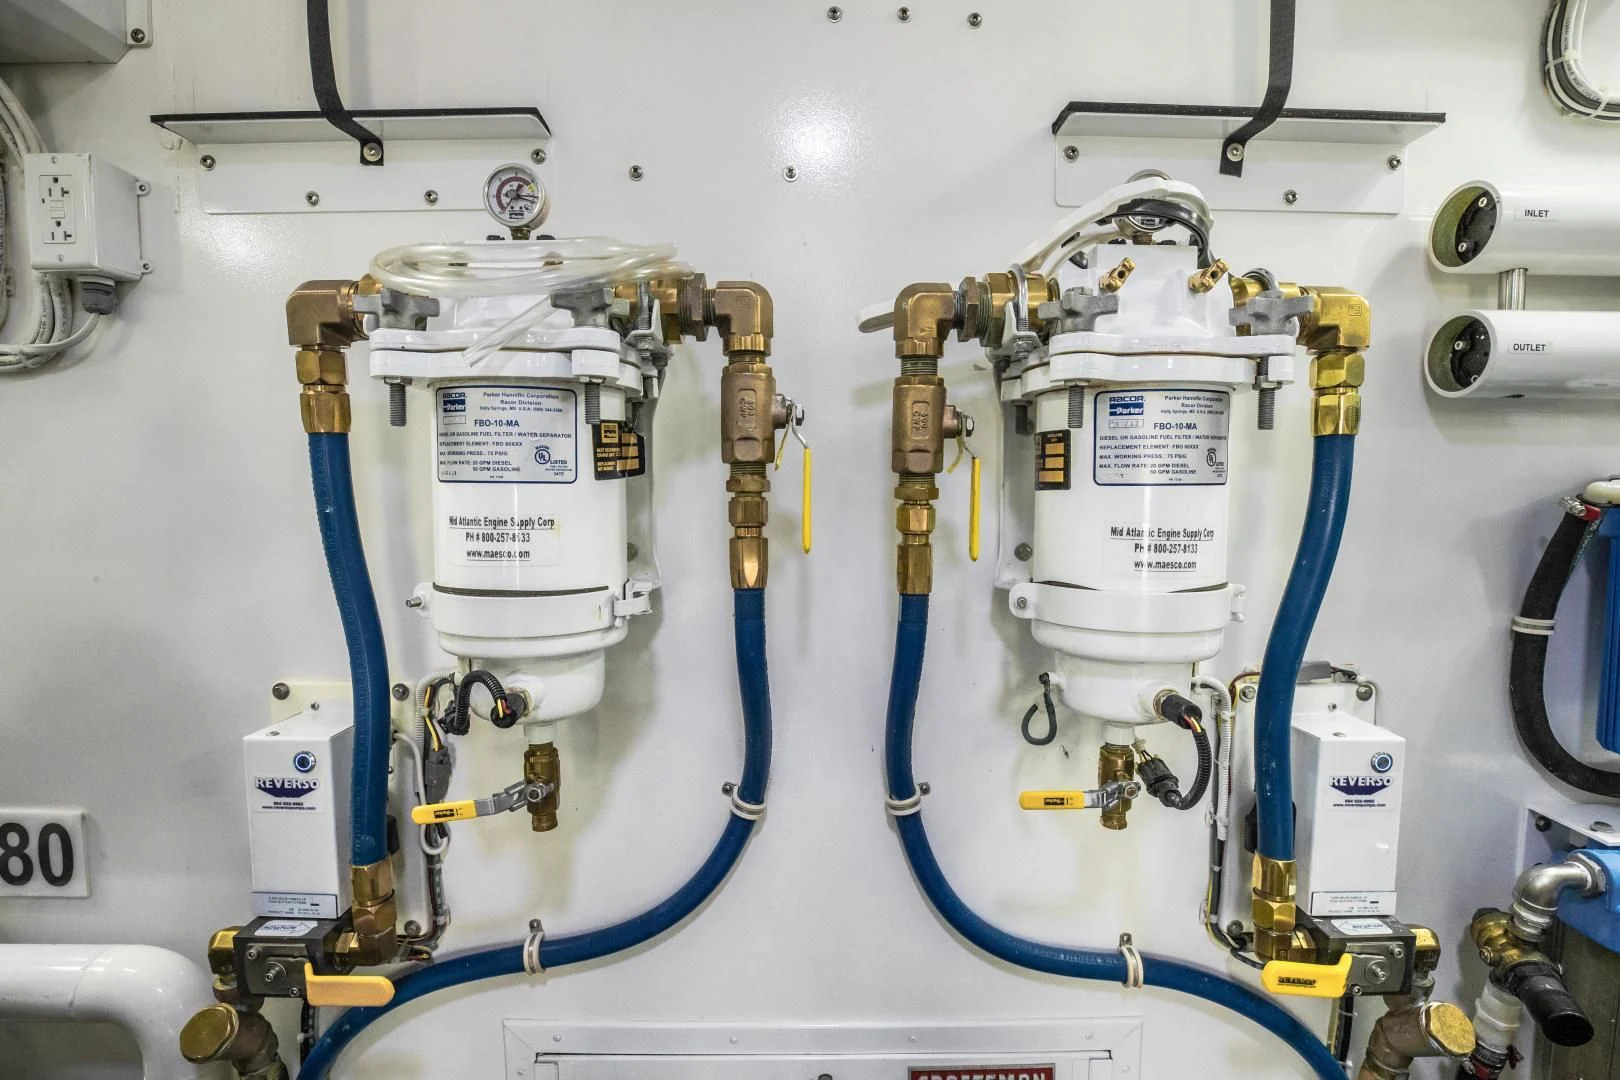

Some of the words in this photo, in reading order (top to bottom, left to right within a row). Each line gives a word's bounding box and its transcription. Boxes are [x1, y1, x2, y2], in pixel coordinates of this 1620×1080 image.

[1524, 209, 1549, 217] INLET
[1513, 343, 1546, 351] OUTLET
[447, 404, 466, 412] Parker
[1116, 406, 1144, 414] Parker
[474, 419, 520, 428] FBO-10-MA
[1154, 422, 1198, 430] FBO-10-MA
[459, 516, 482, 526] Atlantic
[484, 516, 508, 530] Engine
[538, 517, 555, 530] Corp
[466, 532, 474, 542] PH
[476, 532, 480, 541] #
[482, 532, 531, 543] 800-257-8133
[1110, 526, 1124, 537] Mid
[1126, 527, 1155, 538] Atlaic
[1157, 528, 1180, 540] Engine
[1182, 528, 1202, 541] Supply
[1203, 528, 1214, 540] Corp
[1134, 544, 1144, 552] PH
[1147, 544, 1152, 552] #
[1154, 544, 1198, 554] 800-257-8133
[466, 550, 530, 558] www.maesco.com
[255, 777, 320, 789] REVERSO
[1329, 776, 1394, 787] REVERSO
[0, 823, 74, 886] 80
